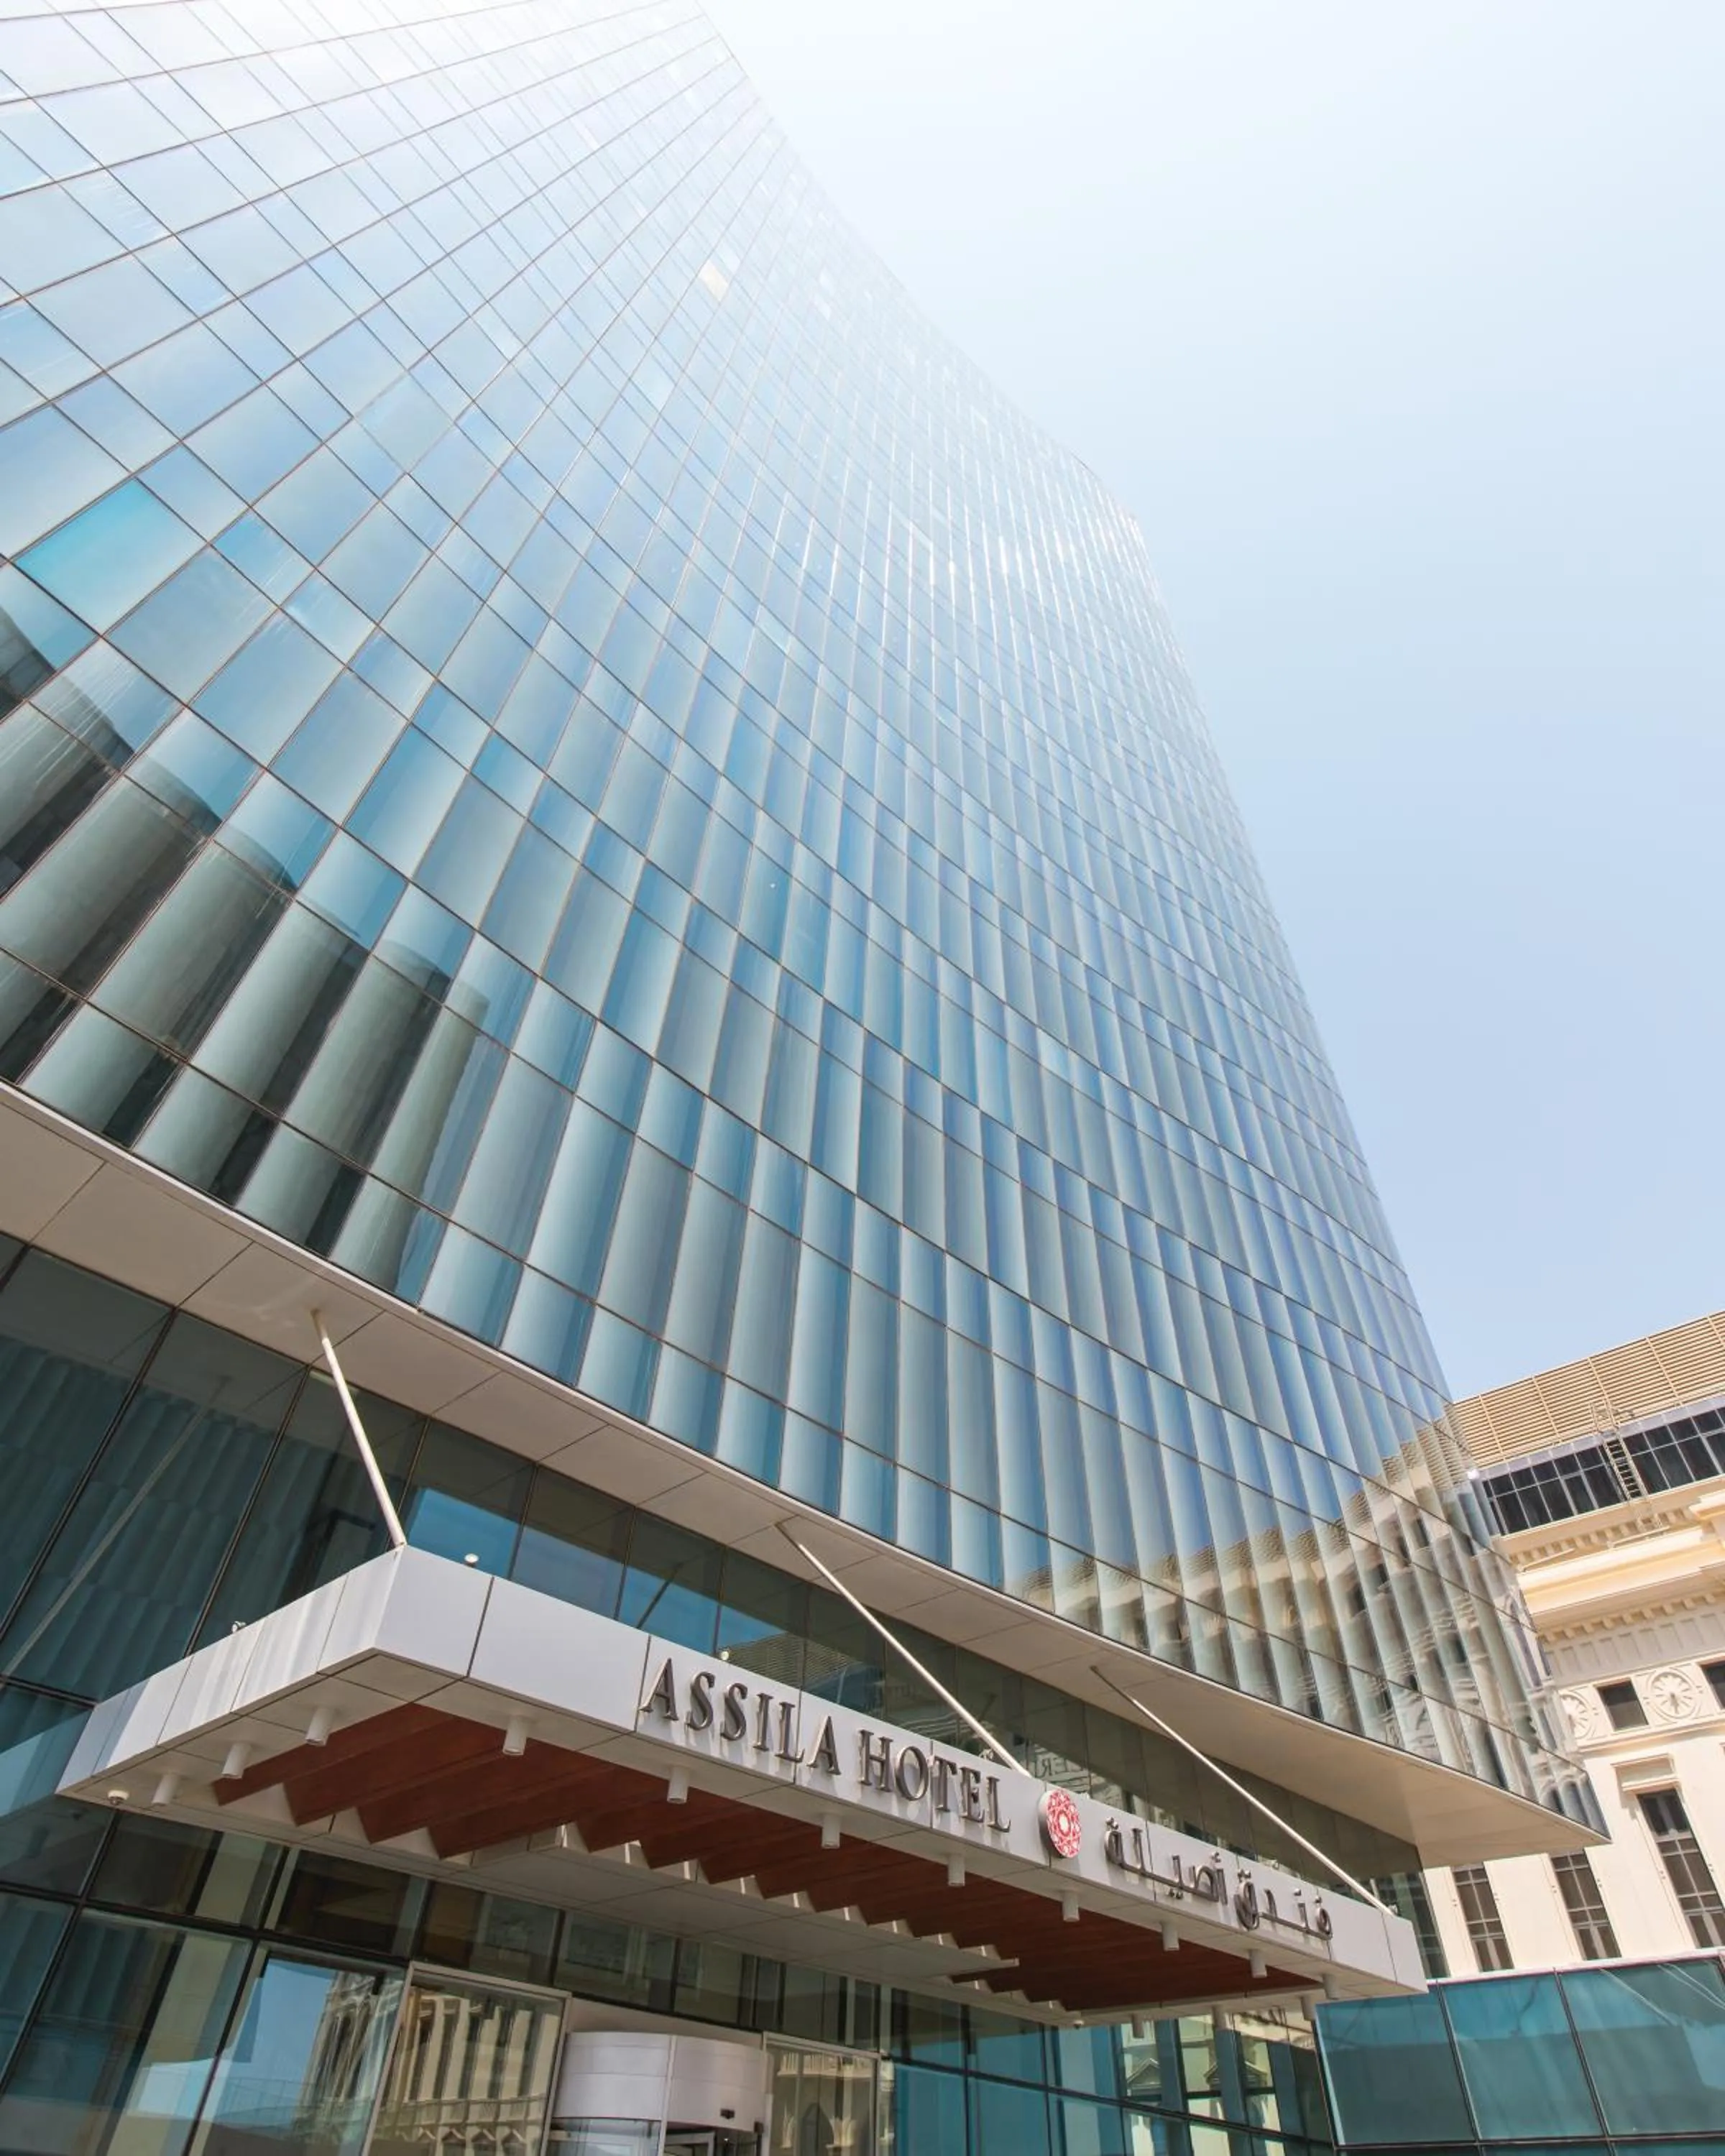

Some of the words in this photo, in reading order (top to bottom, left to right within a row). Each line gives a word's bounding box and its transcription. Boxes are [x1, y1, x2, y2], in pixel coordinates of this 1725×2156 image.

[639, 1658, 841, 1775] ASSILA
[859, 1729, 1011, 1832] HOTEL
[1104, 1816, 1228, 1905] أصيلة
[1235, 1868, 1333, 1940] فندق
